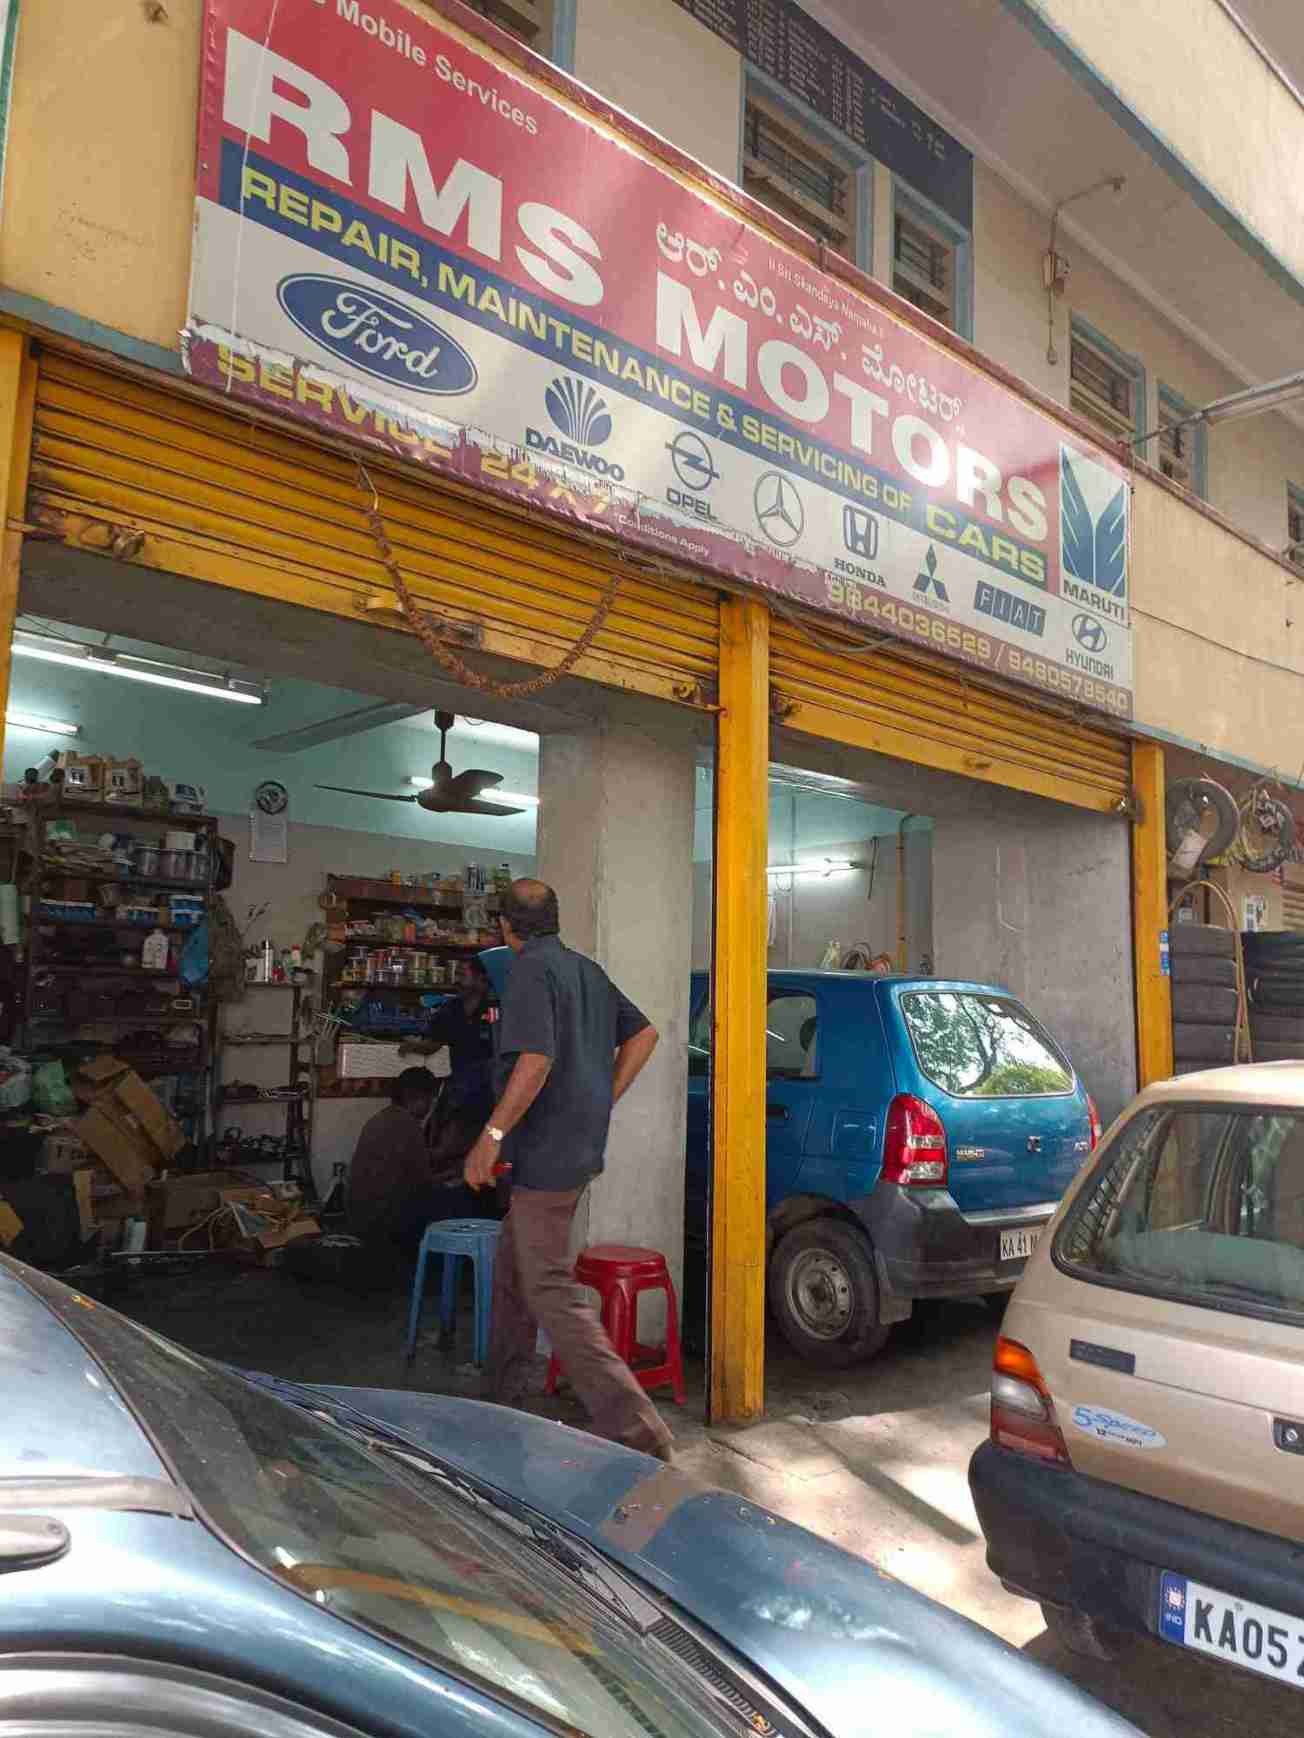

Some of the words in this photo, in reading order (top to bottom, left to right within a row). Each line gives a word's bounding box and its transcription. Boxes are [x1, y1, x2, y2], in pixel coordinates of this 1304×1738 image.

[336, 0, 427, 65] Mobile
[436, 54, 538, 136] Services
[222, 27, 604, 306] RMS
[655, 270, 1048, 543] MOTORS
[321, 292, 440, 378] Ford
[242, 165, 429, 288] REPAIR,
[438, 262, 711, 419] MAINTENANCE
[717, 401, 737, 431] &
[741, 415, 879, 498] SERVICING
[880, 479, 913, 512] OF
[926, 503, 1047, 583] CARS
[525, 427, 625, 481] DAEWOO
[666, 487, 718, 521] OPEL
[679, 537, 709, 557] Apply
[833, 557, 888, 588] HONDA
[980, 584, 1042, 635] FIAT
[1063, 579, 1126, 622] MARUTI
[1065, 648, 1114, 680] HYUNDAI
